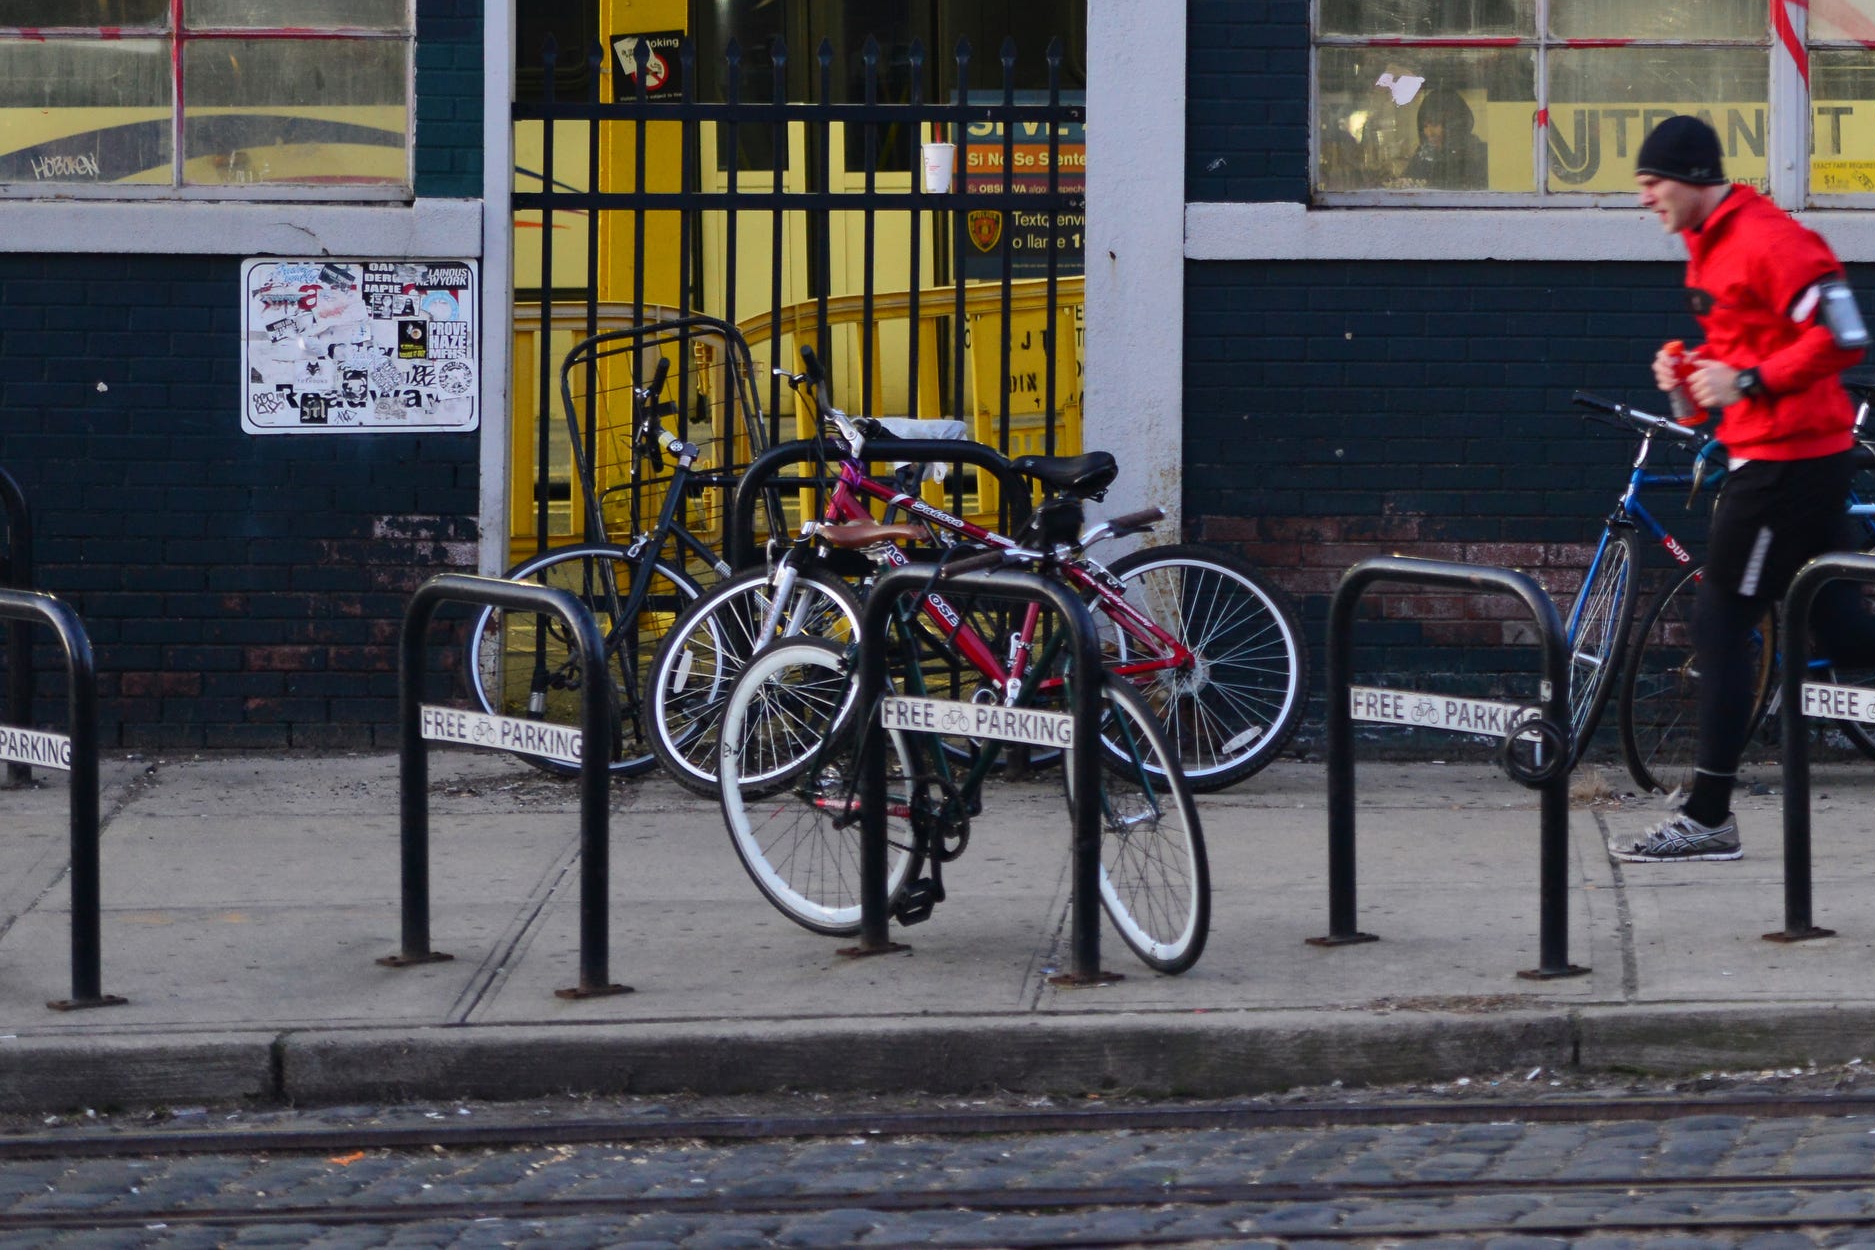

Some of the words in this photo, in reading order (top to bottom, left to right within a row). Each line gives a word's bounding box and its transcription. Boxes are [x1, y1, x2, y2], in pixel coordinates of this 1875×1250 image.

[1603, 106, 1852, 157] TANT
[1014, 153, 1034, 166] Se
[1039, 153, 1086, 166] Sente
[979, 184, 1027, 194] OBSVA
[1028, 234, 1066, 249] llae
[429, 322, 467, 335] PROVE
[429, 336, 467, 348] HAZE
[911, 501, 965, 528] Sahara
[1353, 692, 1404, 720] FREE
[1805, 687, 1859, 717] FREE
[423, 710, 467, 739] FREE
[502, 720, 583, 758] PARKING
[884, 700, 935, 728] FREE
[975, 708, 1072, 743] PARKING
[0, 730, 71, 766] PARKING
